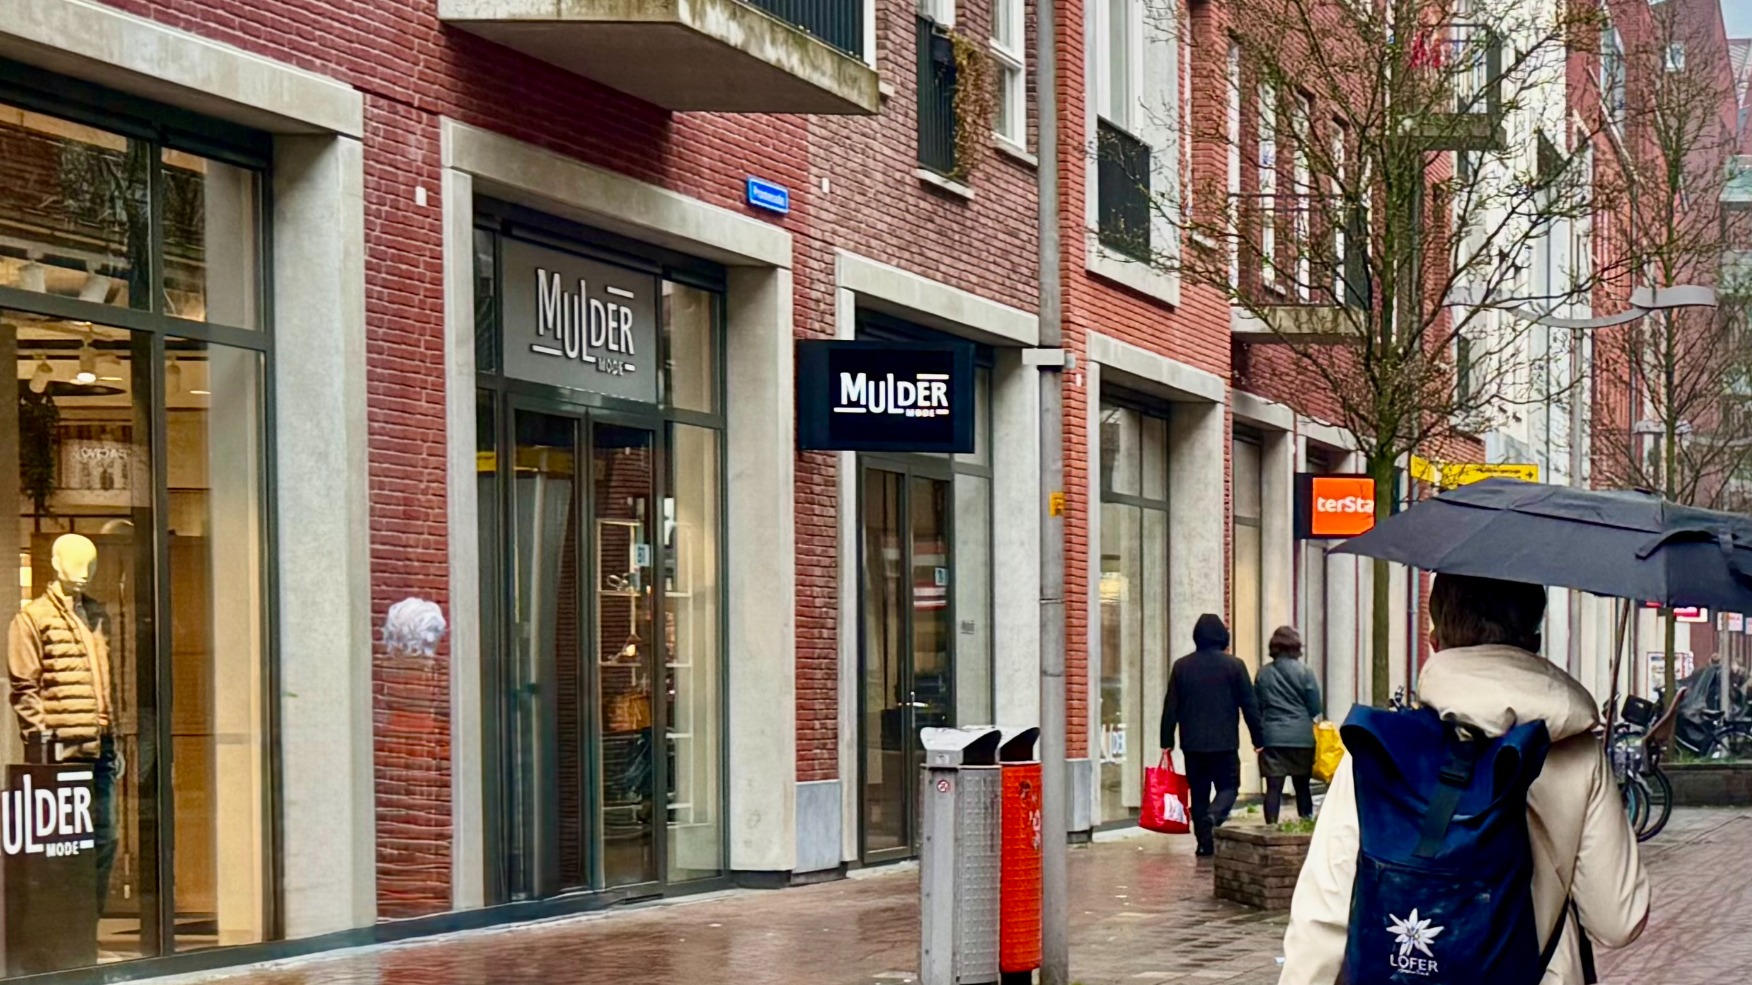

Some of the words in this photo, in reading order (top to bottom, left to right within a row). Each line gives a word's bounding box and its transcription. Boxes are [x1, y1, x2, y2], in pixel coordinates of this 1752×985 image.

[537, 268, 635, 362] MULDER
[598, 358, 624, 376] MODE
[840, 372, 949, 414] MULDER
[1317, 496, 1374, 513] terSta
[2, 774, 94, 855] ULDER
[46, 841, 79, 857] MODE
[1389, 954, 1439, 973] LOFER
